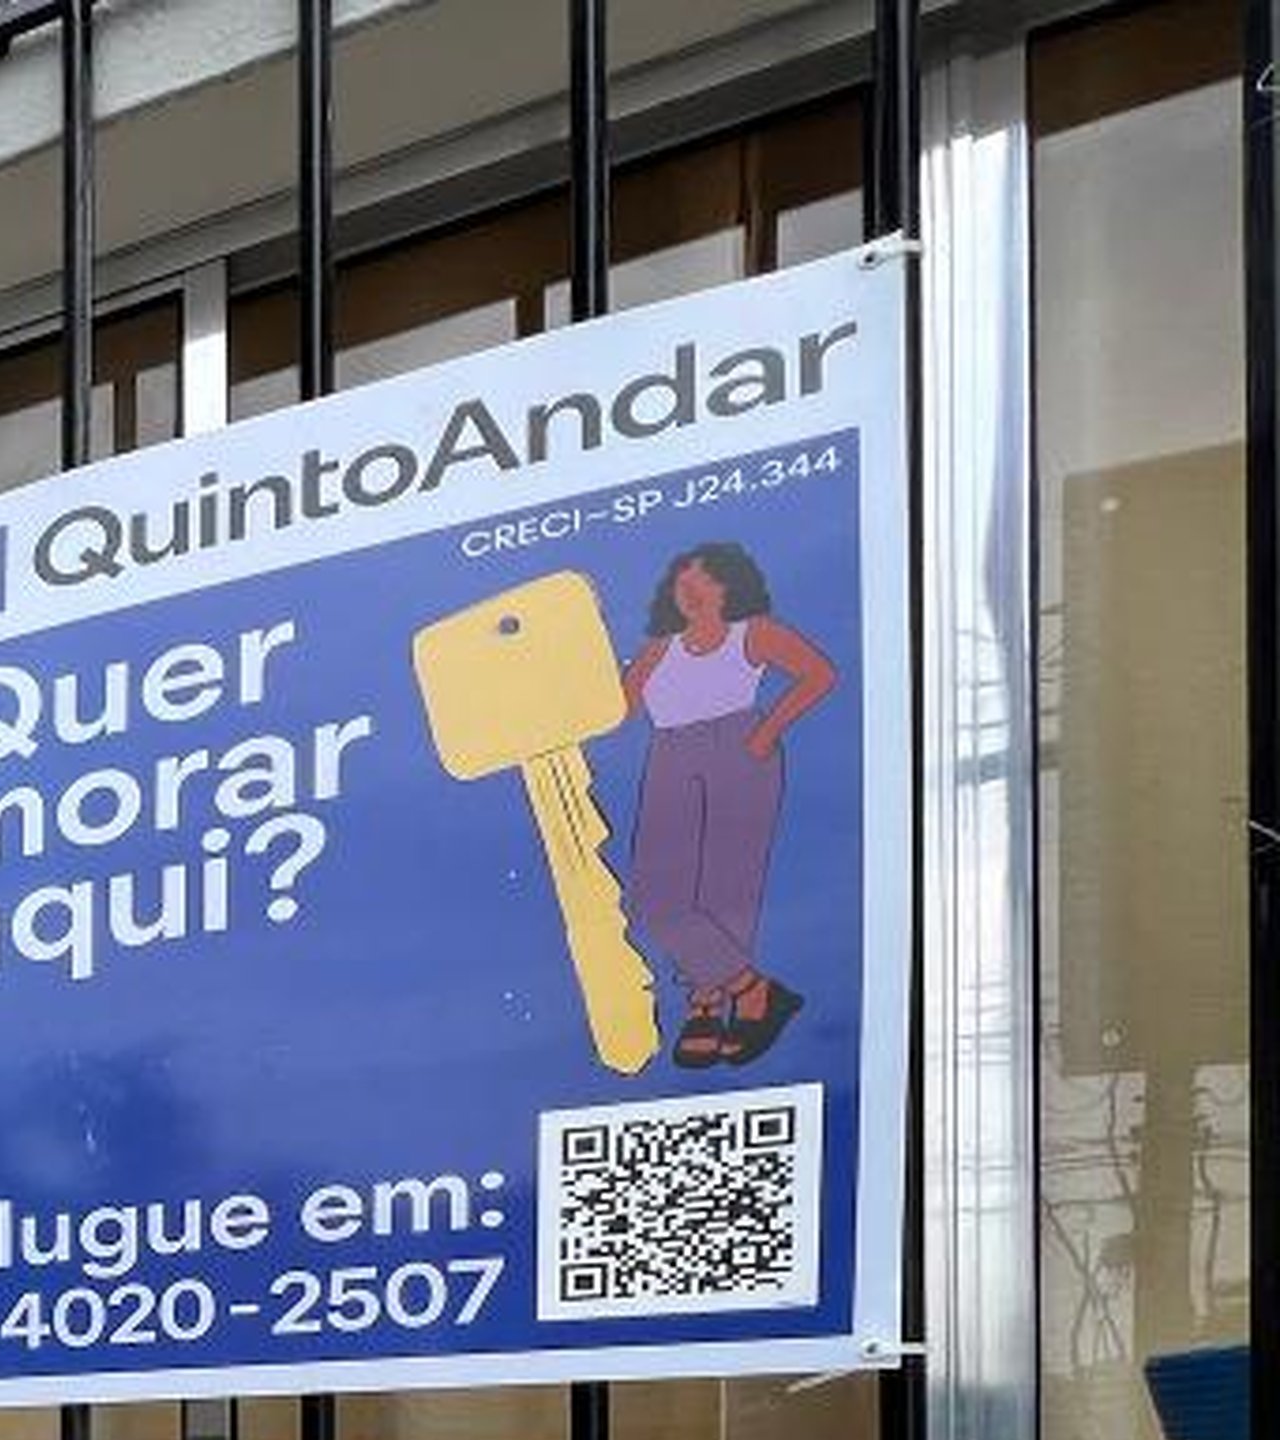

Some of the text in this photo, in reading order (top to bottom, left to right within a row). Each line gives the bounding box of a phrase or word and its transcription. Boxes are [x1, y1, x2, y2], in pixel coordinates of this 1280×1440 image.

[33, 319, 858, 588] QuintoAndar
[675, 446, 841, 508] J24.344
[300, 1166, 506, 1242] em:
[0, 1257, 505, 1351] 4020-2507
